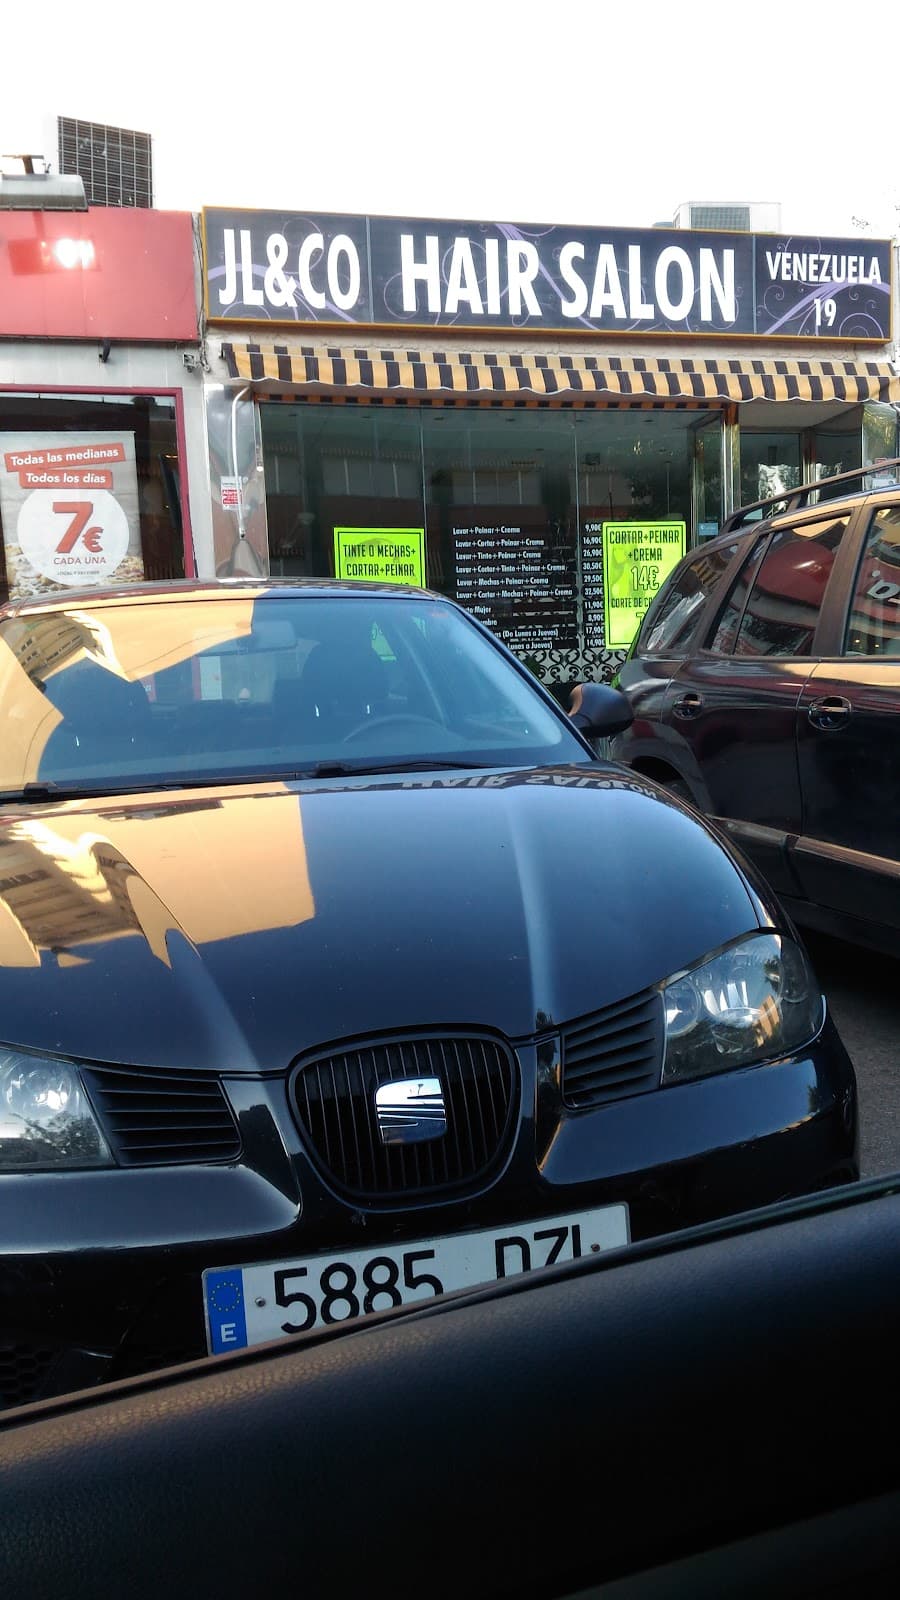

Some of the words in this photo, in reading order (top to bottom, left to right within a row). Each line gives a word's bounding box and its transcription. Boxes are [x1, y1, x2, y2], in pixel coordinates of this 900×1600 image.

[219, 229, 360, 310] JL&CO
[401, 234, 542, 316] HAIR
[559, 241, 735, 322] SALON
[766, 251, 881, 285] VENEZUELA
[814, 299, 837, 326] 19
[10, 455, 44, 466] Todas
[47, 453, 62, 463] las
[65, 449, 119, 461] medianas
[26, 473, 60, 483] Todos
[63, 472, 79, 483] los
[83, 473, 106, 483] días
[343, 544, 366, 557] TINTE
[369, 545, 375, 557] O
[628, 548, 662, 561] +CREMA
[631, 566, 659, 591] 14€
[611, 597, 632, 608] CORTE
[633, 597, 642, 607] DE
[274, 1249, 444, 1334] 5885
[220, 1323, 237, 1343] E
